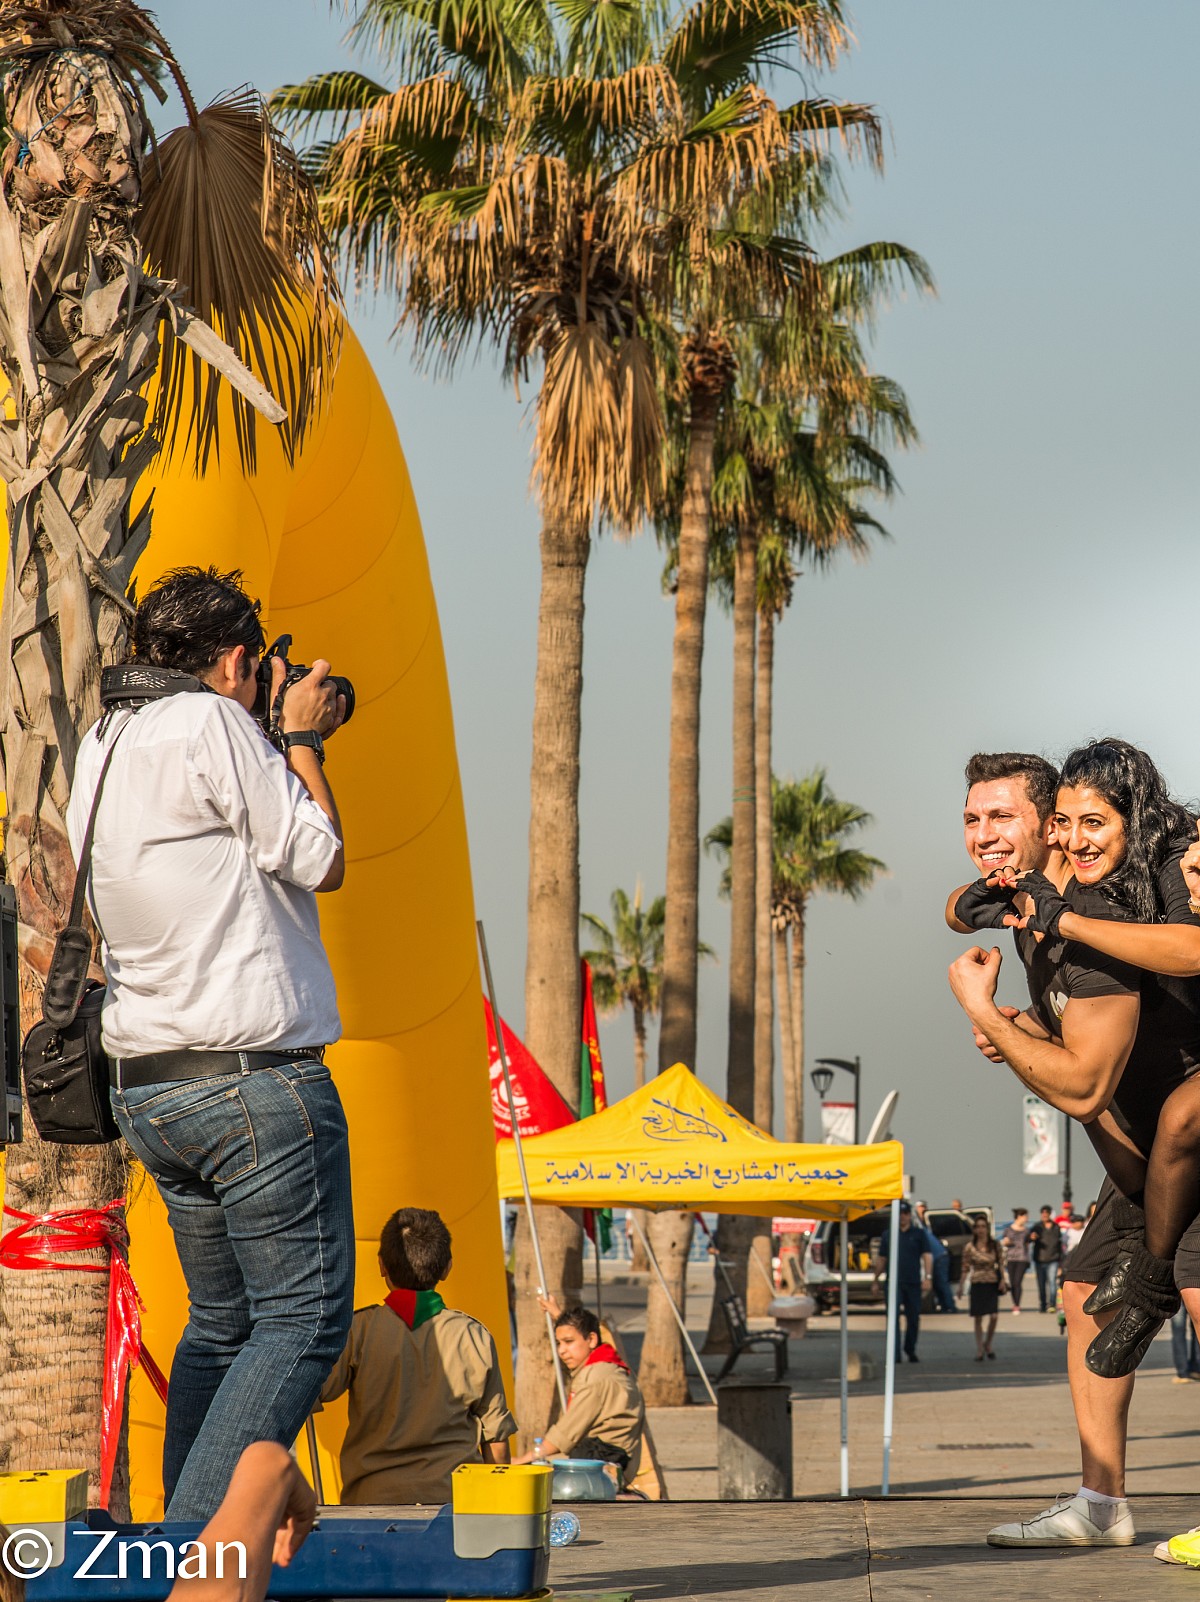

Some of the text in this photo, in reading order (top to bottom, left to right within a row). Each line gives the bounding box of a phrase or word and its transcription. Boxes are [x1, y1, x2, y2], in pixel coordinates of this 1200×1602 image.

[639, 1162, 709, 1187] الخيرية
[712, 1162, 785, 1189] المشاريع
[787, 1163, 849, 1186] جمعية
